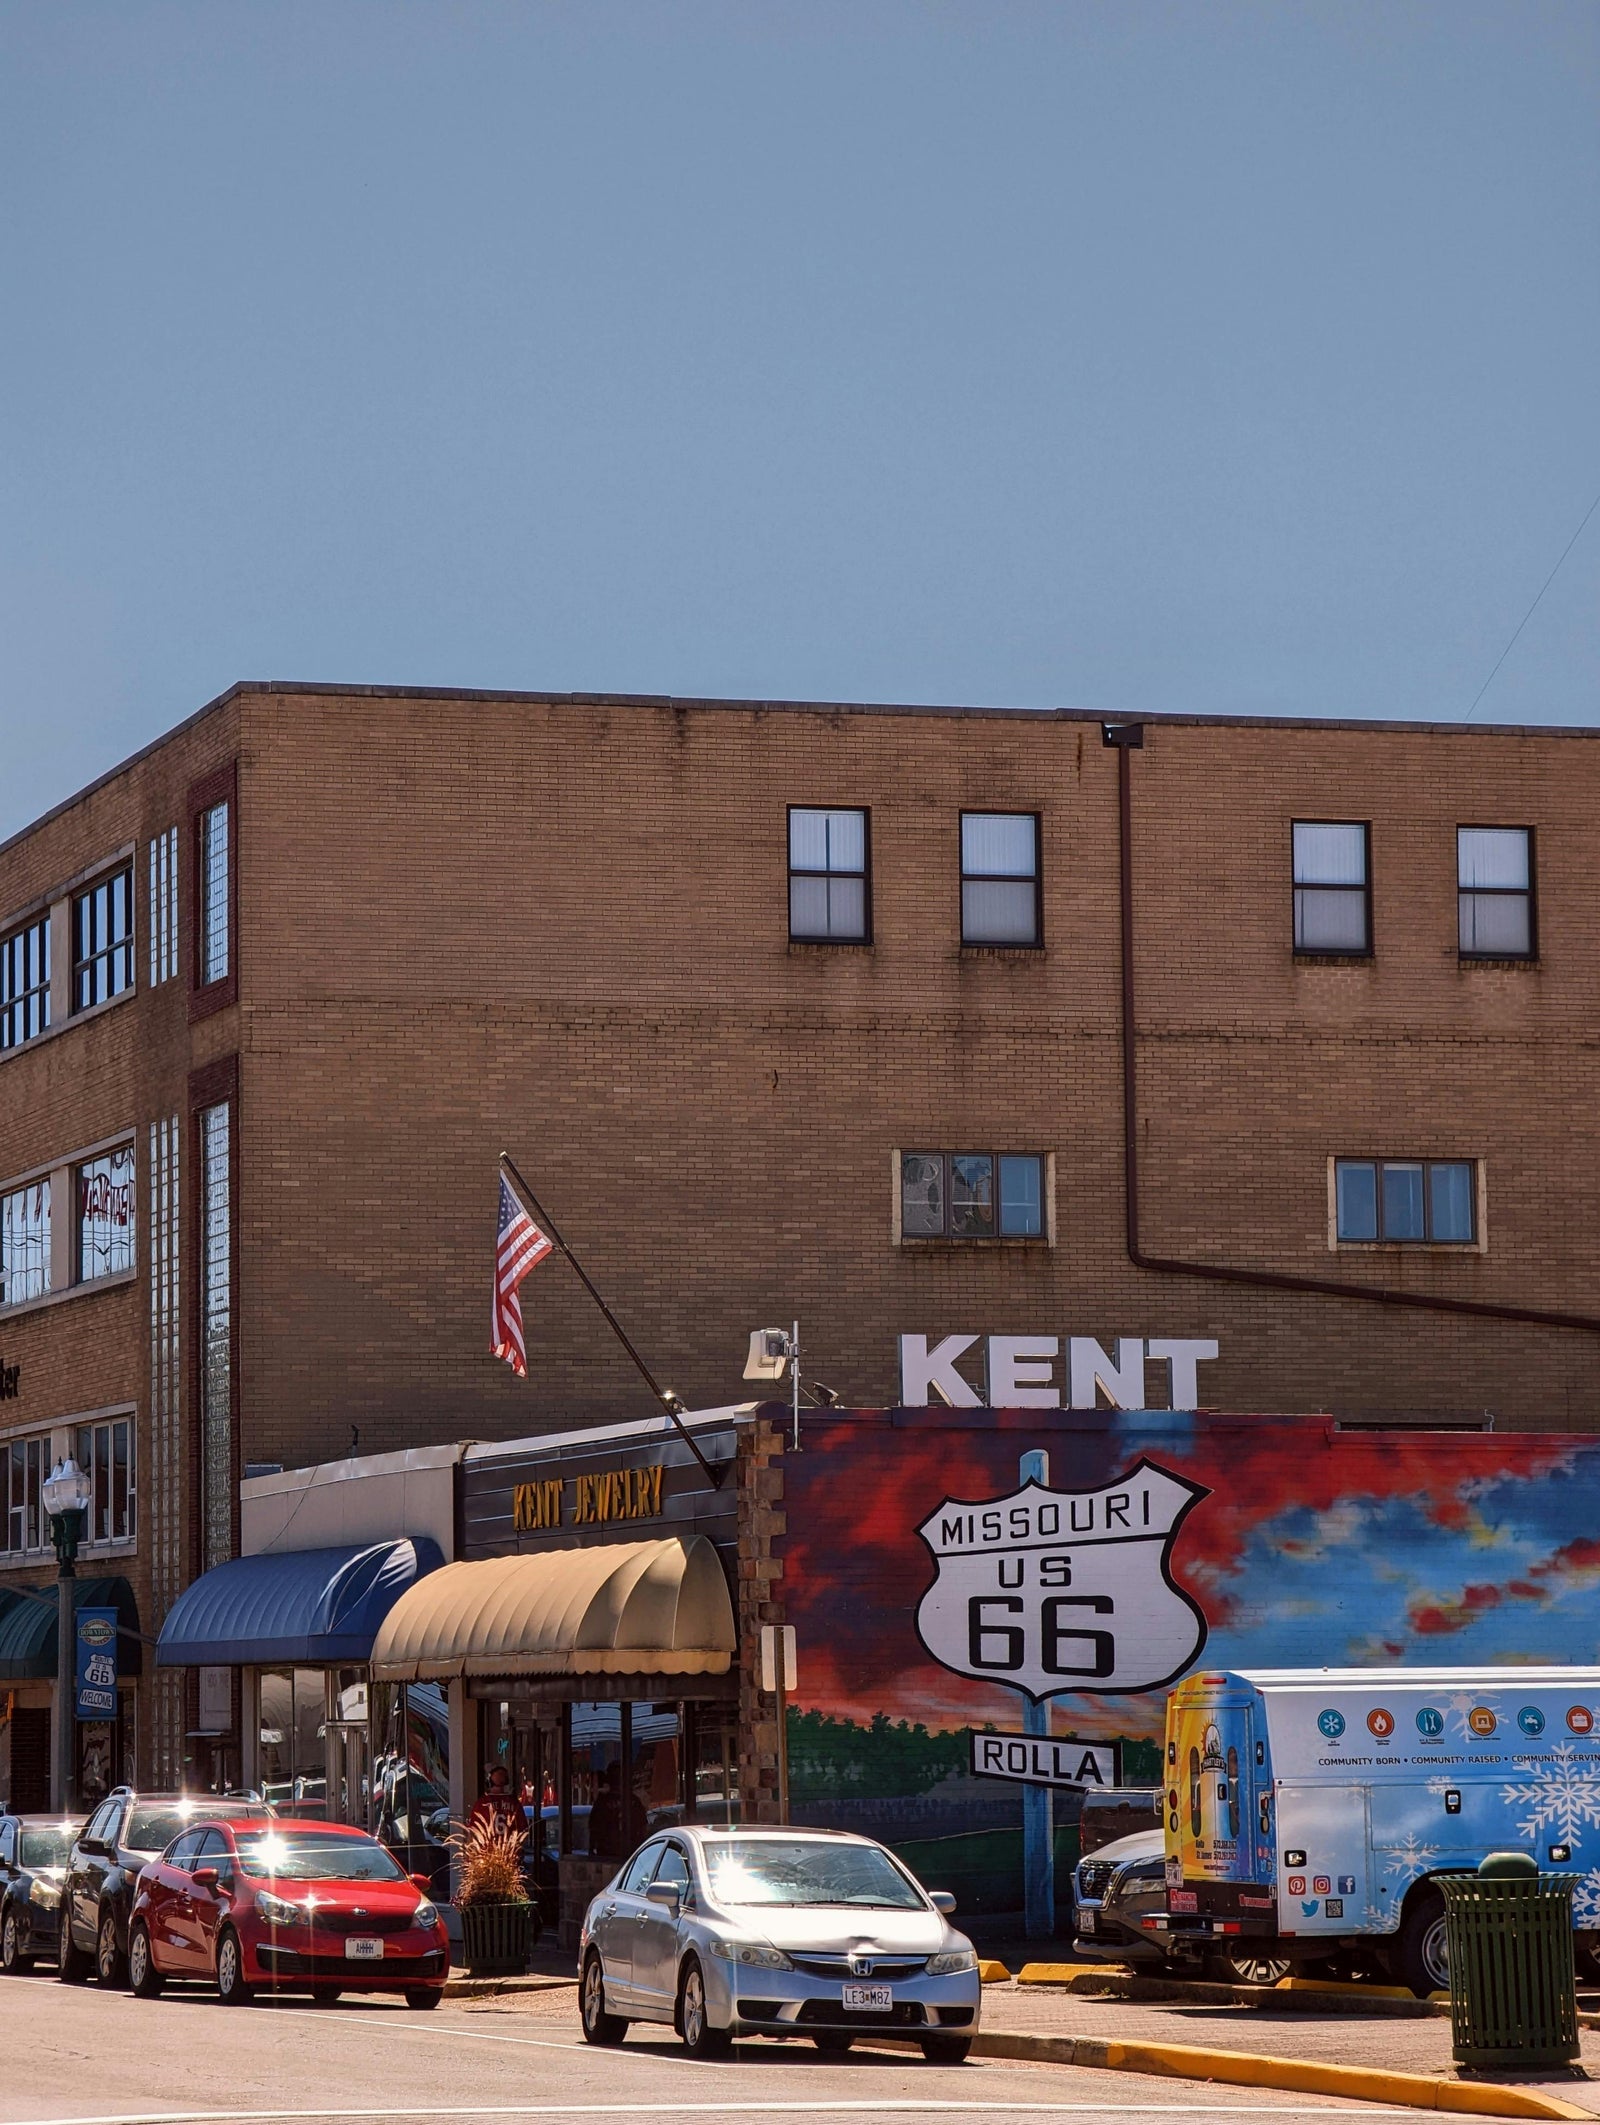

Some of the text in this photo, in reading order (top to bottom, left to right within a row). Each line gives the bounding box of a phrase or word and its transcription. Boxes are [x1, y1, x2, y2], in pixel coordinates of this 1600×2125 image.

[900, 1334, 1218, 1410] KENT
[514, 1464, 664, 1531] KENT JEWELRY
[942, 1490, 1150, 1546] MISSOURI
[969, 1596, 1114, 1678] 66
[90, 1669, 109, 1684] 66
[81, 1691, 112, 1707] WELCOME
[984, 1741, 1104, 1785] ROLLA
[1318, 1757, 1372, 1766] COMMUNITY
[1411, 1756, 1465, 1764] COMMUNITY
[1468, 1755, 1501, 1763] RAISED
[1511, 1755, 1565, 1763] COMMUNITY
[845, 1990, 890, 2005] LE3 M8Z
